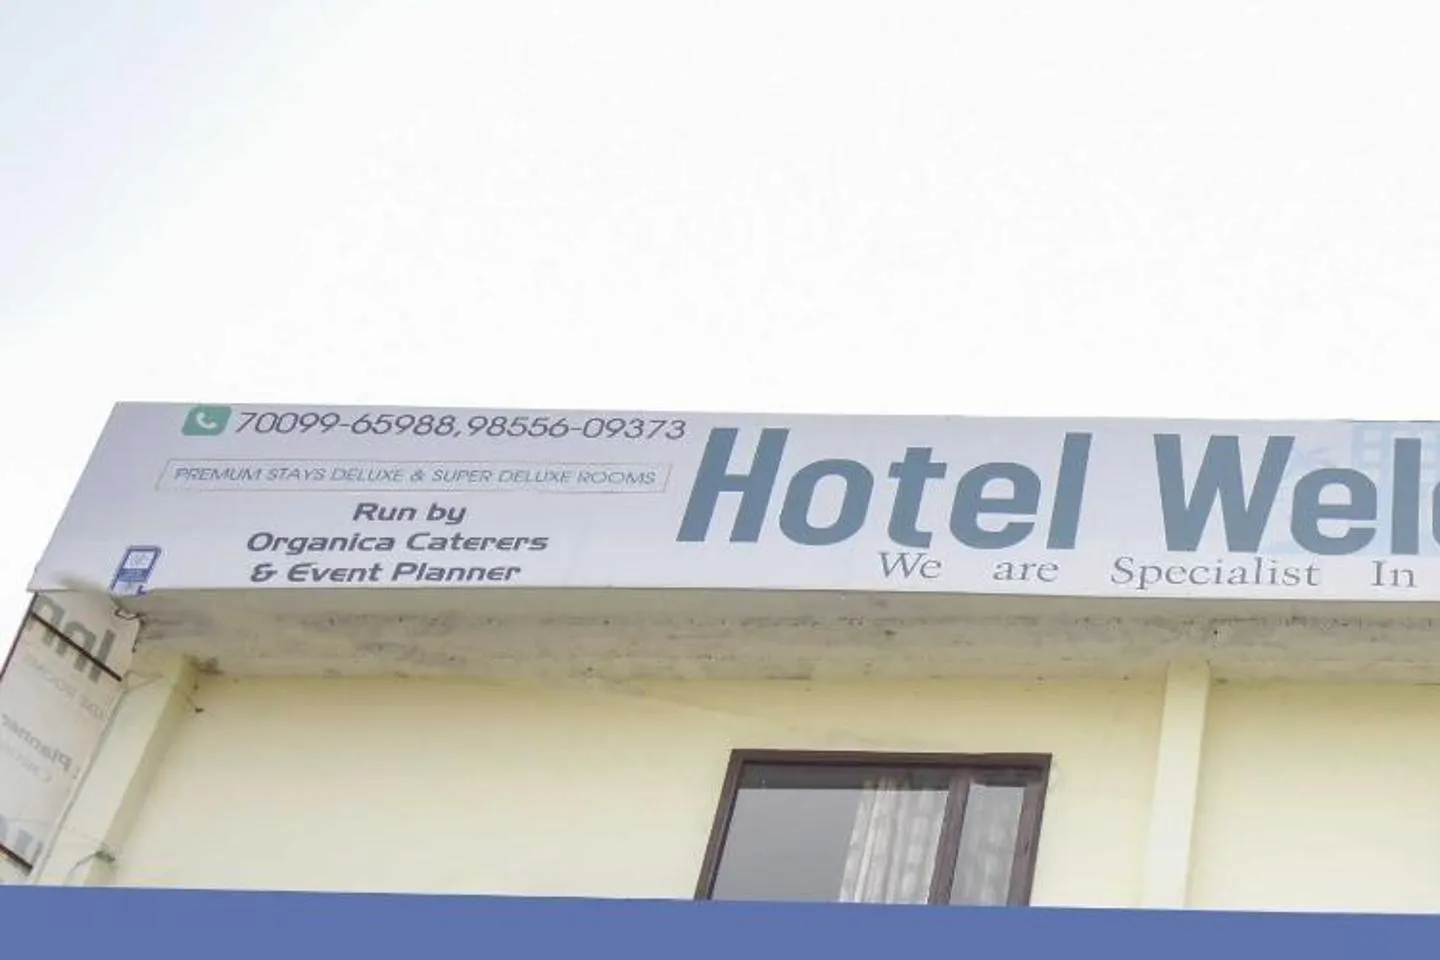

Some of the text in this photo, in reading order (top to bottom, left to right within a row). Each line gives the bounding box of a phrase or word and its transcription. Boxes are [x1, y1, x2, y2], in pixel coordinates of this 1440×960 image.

[266, 466, 326, 482] STAYS
[330, 467, 402, 483] DELUXE
[410, 469, 426, 482] &
[431, 468, 493, 484] SUPER
[499, 469, 574, 485] DELUXE
[577, 469, 657, 486] ROOMS
[676, 427, 1092, 549] Hotel
[353, 502, 467, 525] Run by
[246, 531, 550, 555] Organica Caterers
[250, 562, 521, 582] & Event Planner
[878, 552, 943, 580] We
[992, 557, 1059, 582] are
[1110, 556, 1321, 588] Specialist
[1371, 560, 1417, 589] In
